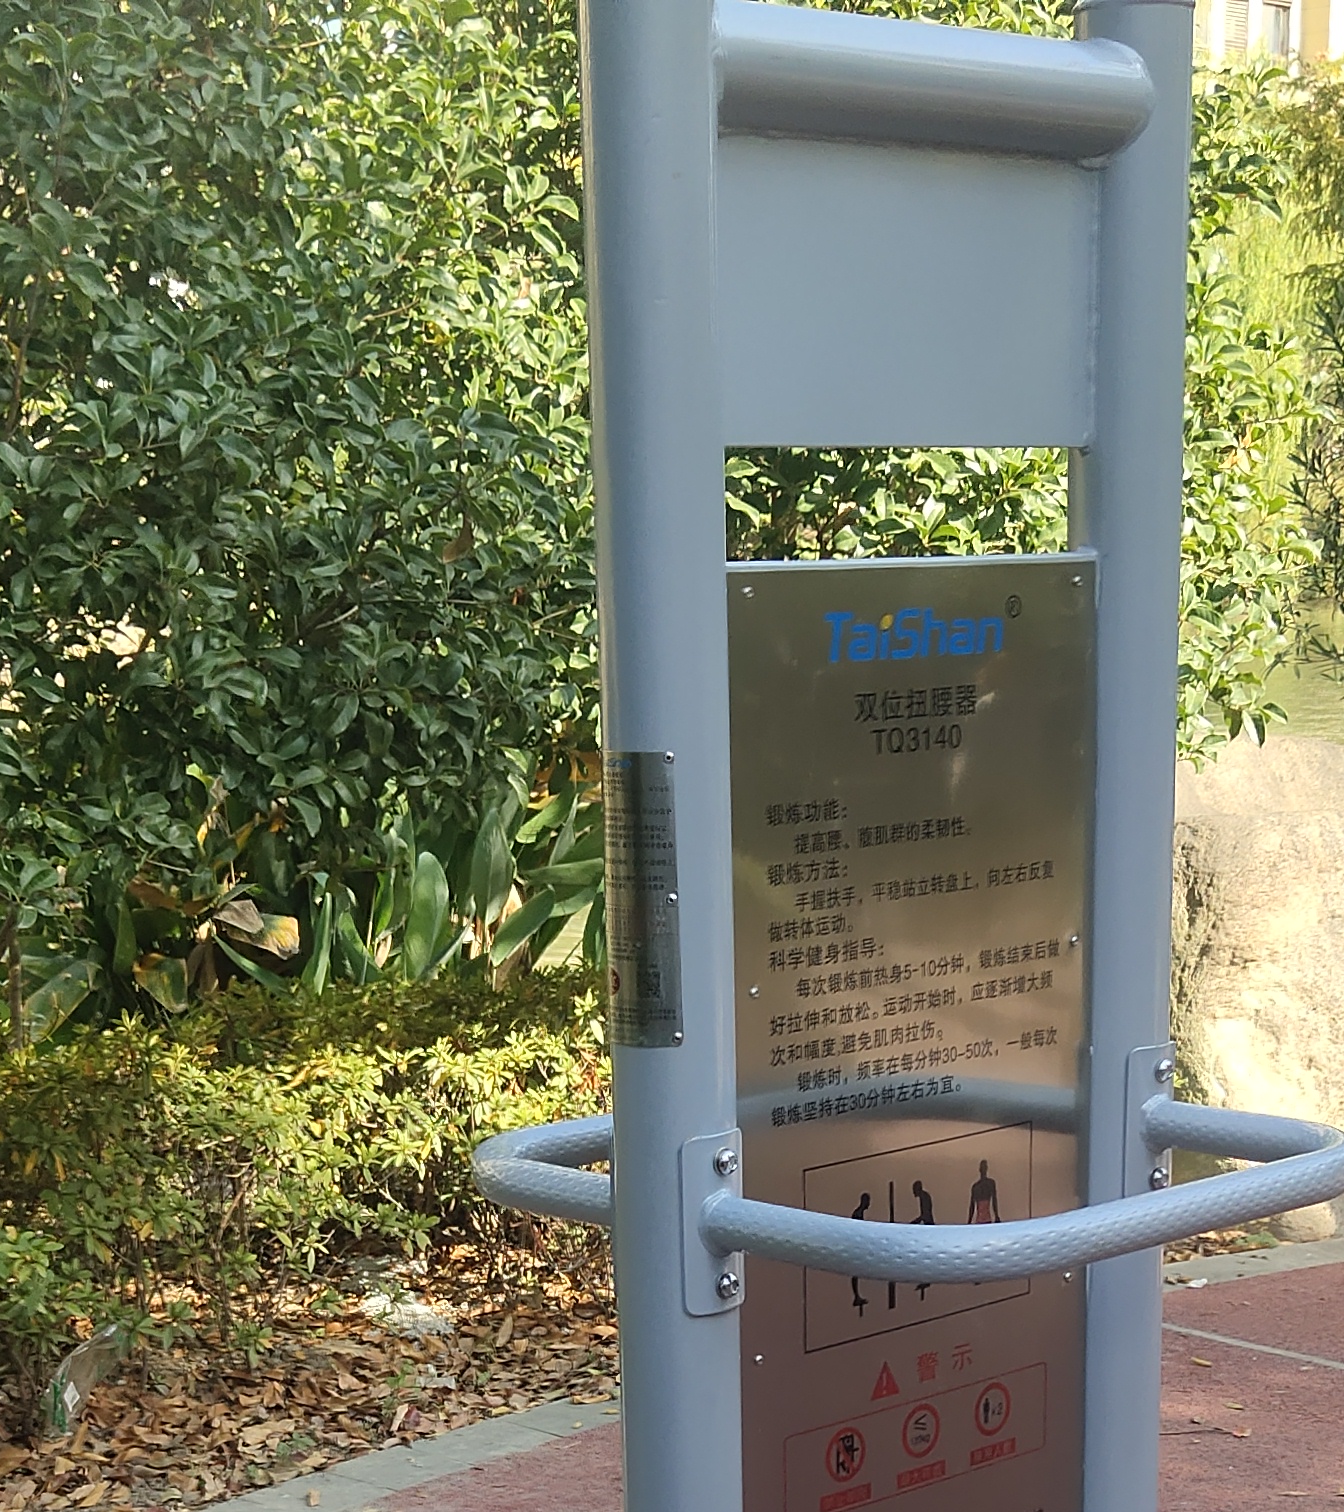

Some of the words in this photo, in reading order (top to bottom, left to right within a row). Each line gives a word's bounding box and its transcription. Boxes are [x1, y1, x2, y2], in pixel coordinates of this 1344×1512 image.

[824, 607, 1004, 663] TaiShan
[854, 685, 978, 722] 双位扭腰器
[871, 724, 963, 755] TQ3140
[765, 799, 848, 827] 锻炼功能：
[768, 858, 848, 886] 锻炼方法：
[768, 914, 853, 942] 做转体运动。
[769, 938, 884, 972] 科学健身指导：
[916, 1342, 973, 1382] 警示
